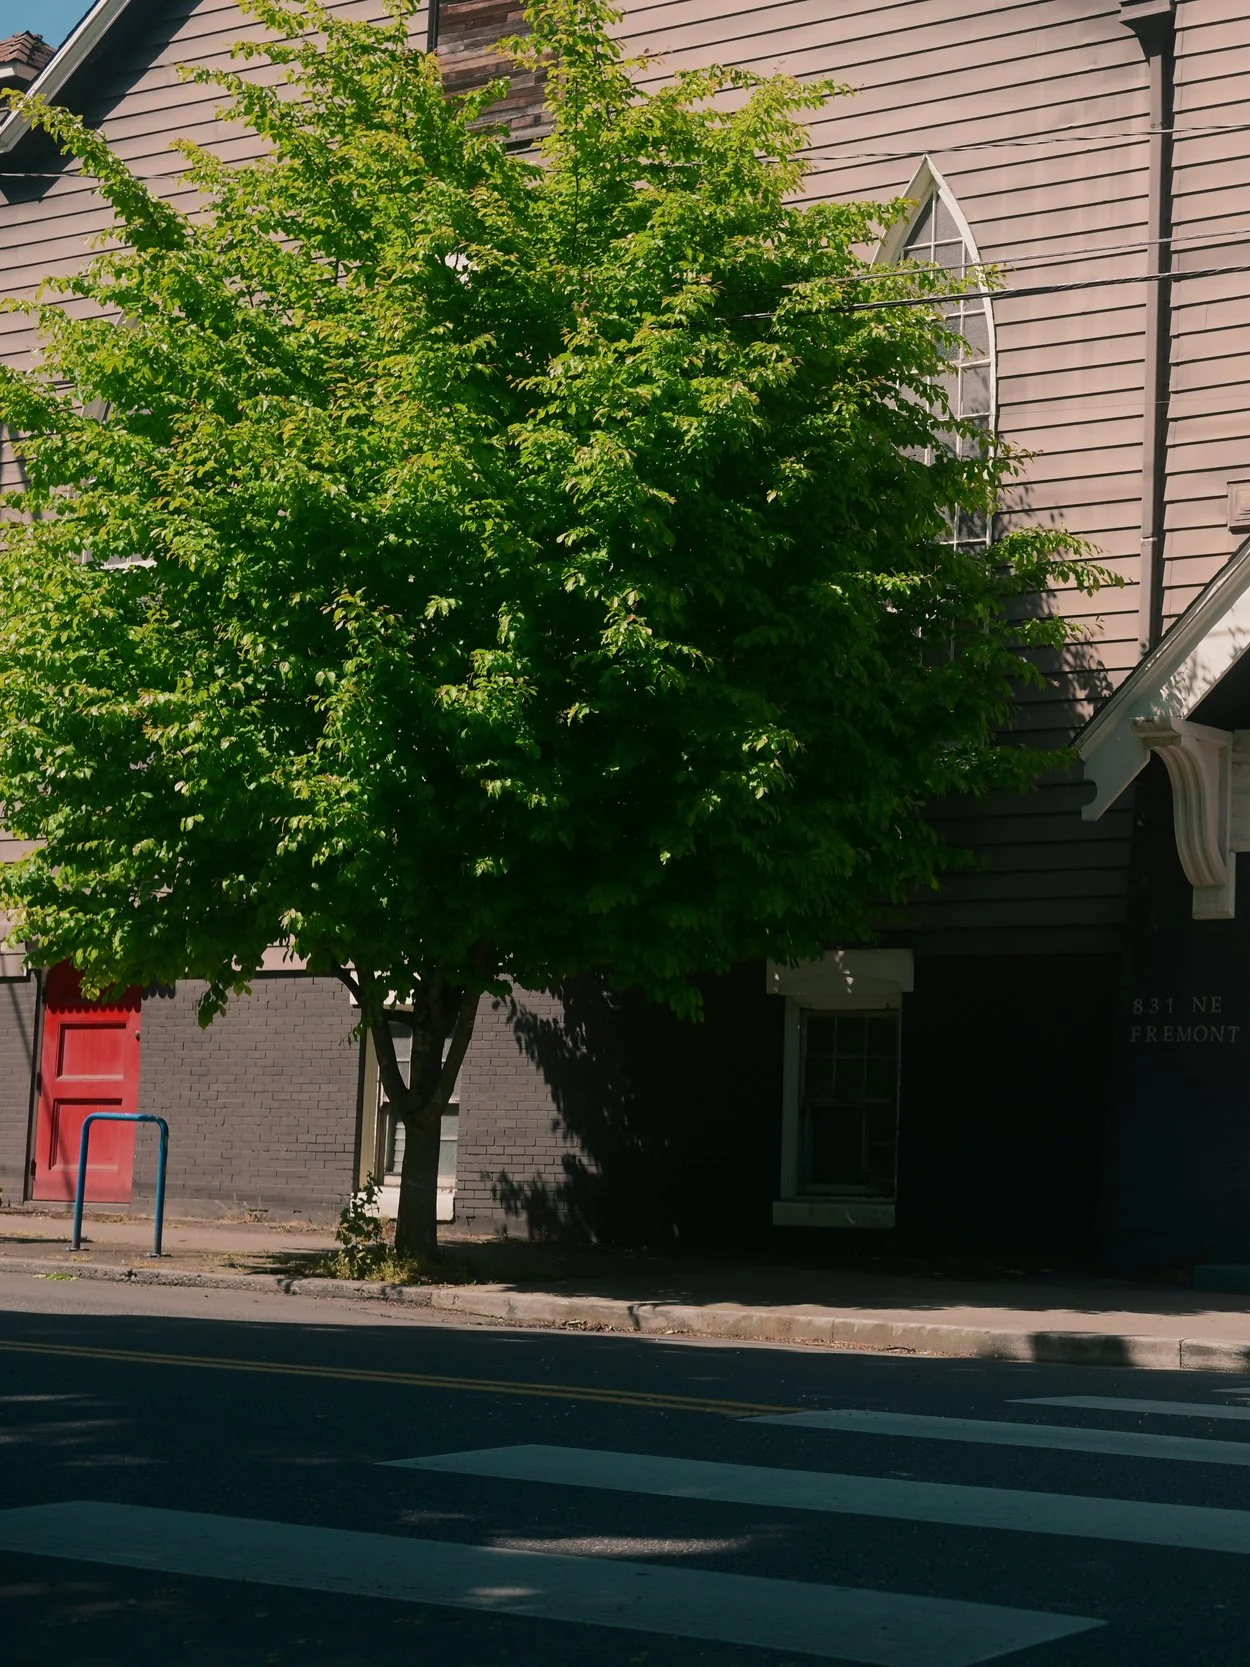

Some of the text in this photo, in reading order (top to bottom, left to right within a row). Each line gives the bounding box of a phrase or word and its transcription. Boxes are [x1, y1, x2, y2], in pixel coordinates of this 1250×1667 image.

[1133, 996, 1222, 1015] 831 NE
[1130, 1025, 1241, 1043] FREMONT
